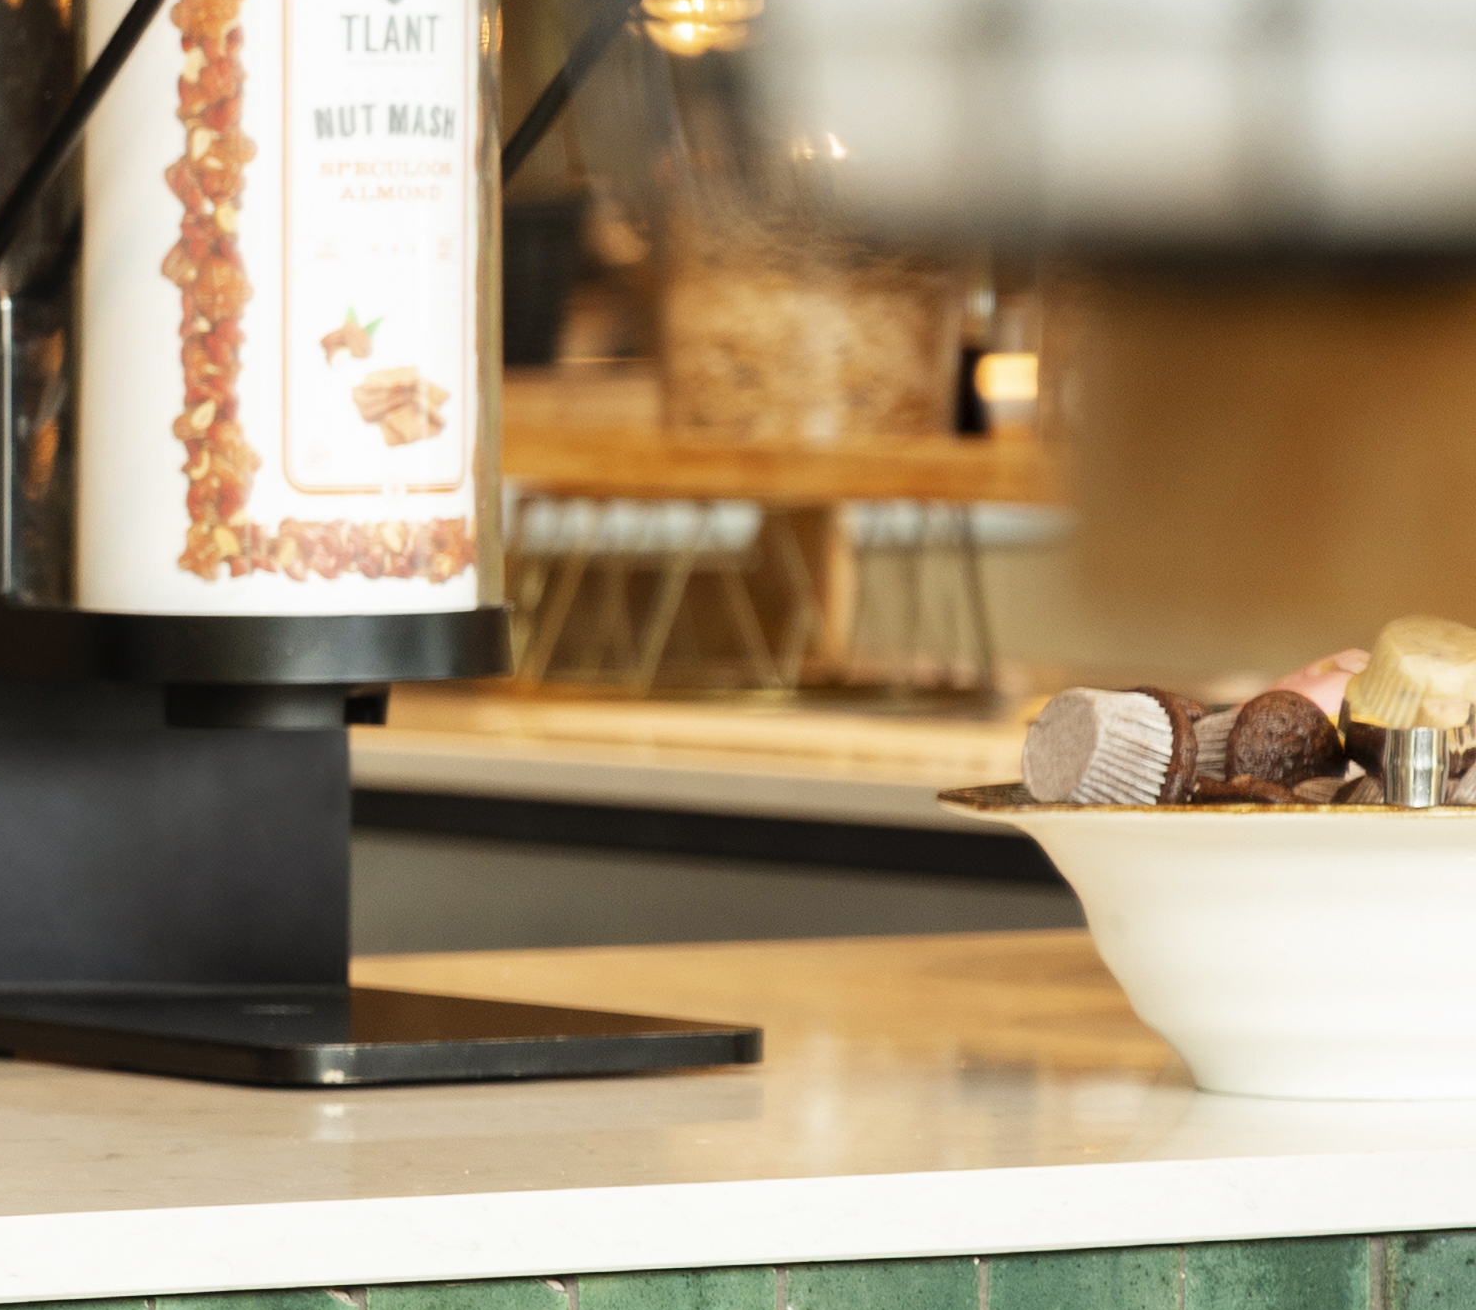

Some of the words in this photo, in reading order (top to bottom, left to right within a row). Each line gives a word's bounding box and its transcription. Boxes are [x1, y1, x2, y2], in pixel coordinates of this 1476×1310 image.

[341, 14, 440, 52] TLANT
[314, 103, 376, 139] NUT
[388, 103, 456, 139] MASH
